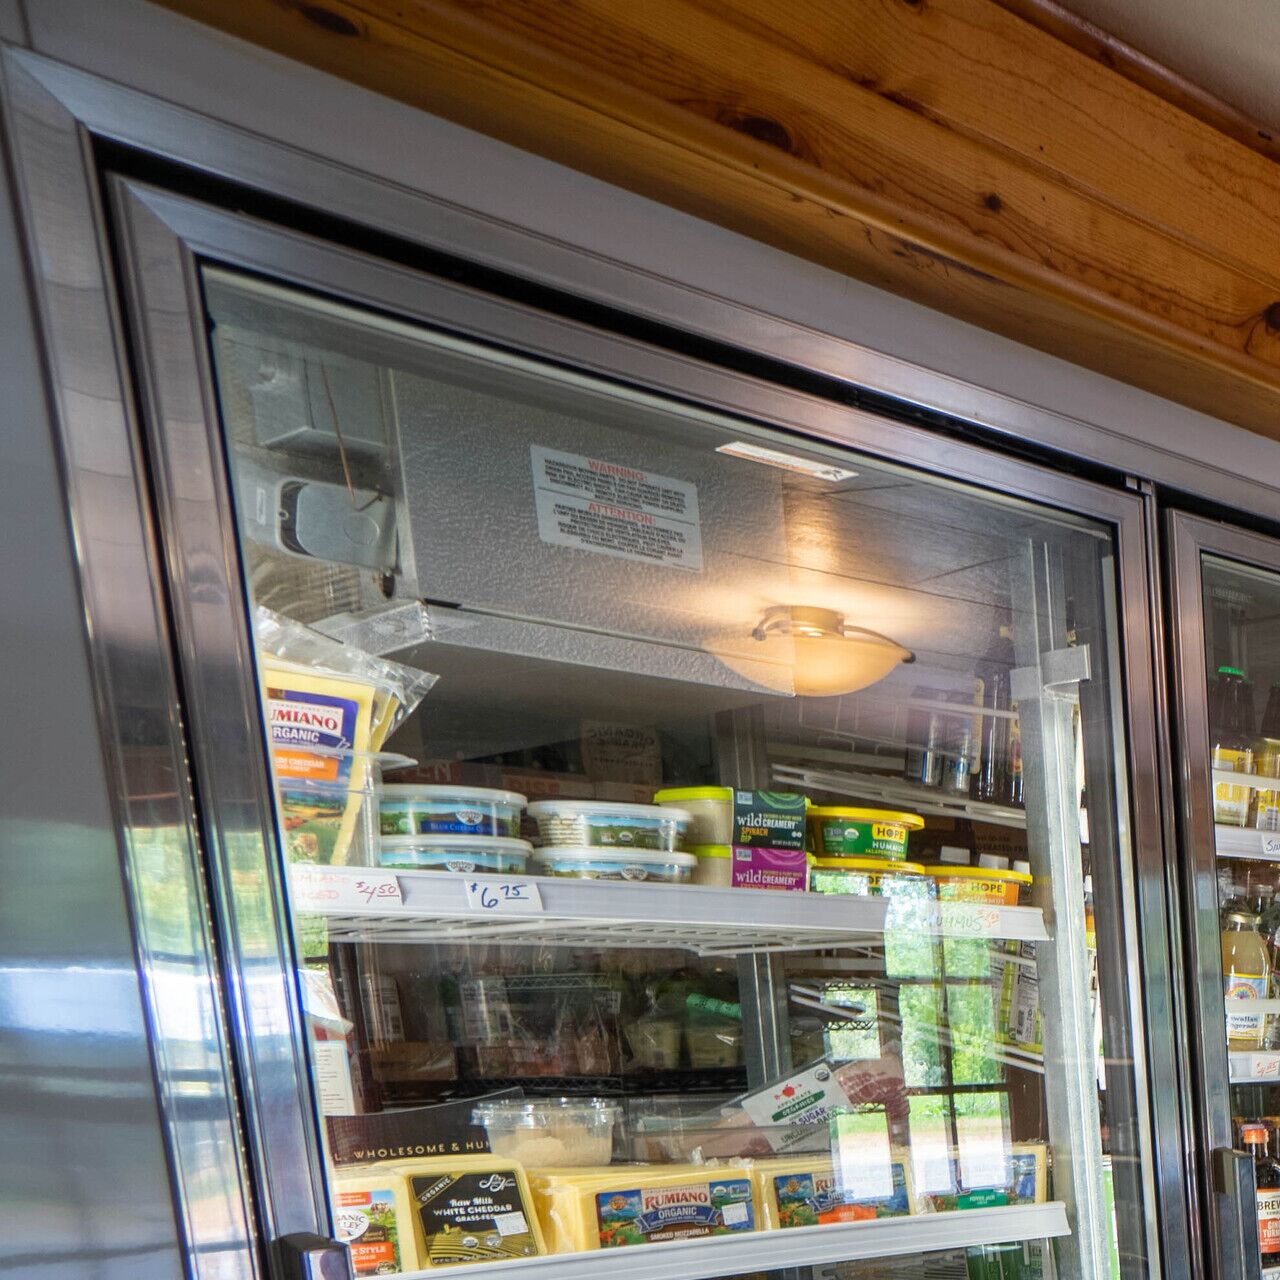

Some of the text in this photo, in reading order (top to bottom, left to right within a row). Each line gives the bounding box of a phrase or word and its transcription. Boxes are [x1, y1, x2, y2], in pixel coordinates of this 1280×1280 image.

[737, 814, 761, 828] wild
[762, 819, 797, 828] CREAMERY
[876, 827, 904, 841] HOPE
[736, 868, 796, 885] wild CREAMERY
[353, 1142, 460, 1161] WHOLESOME &
[644, 1192, 708, 1210] RUMIANO
[433, 1204, 513, 1217] WHITE CHEDDAR
[658, 1206, 697, 1218] ORGANIC
